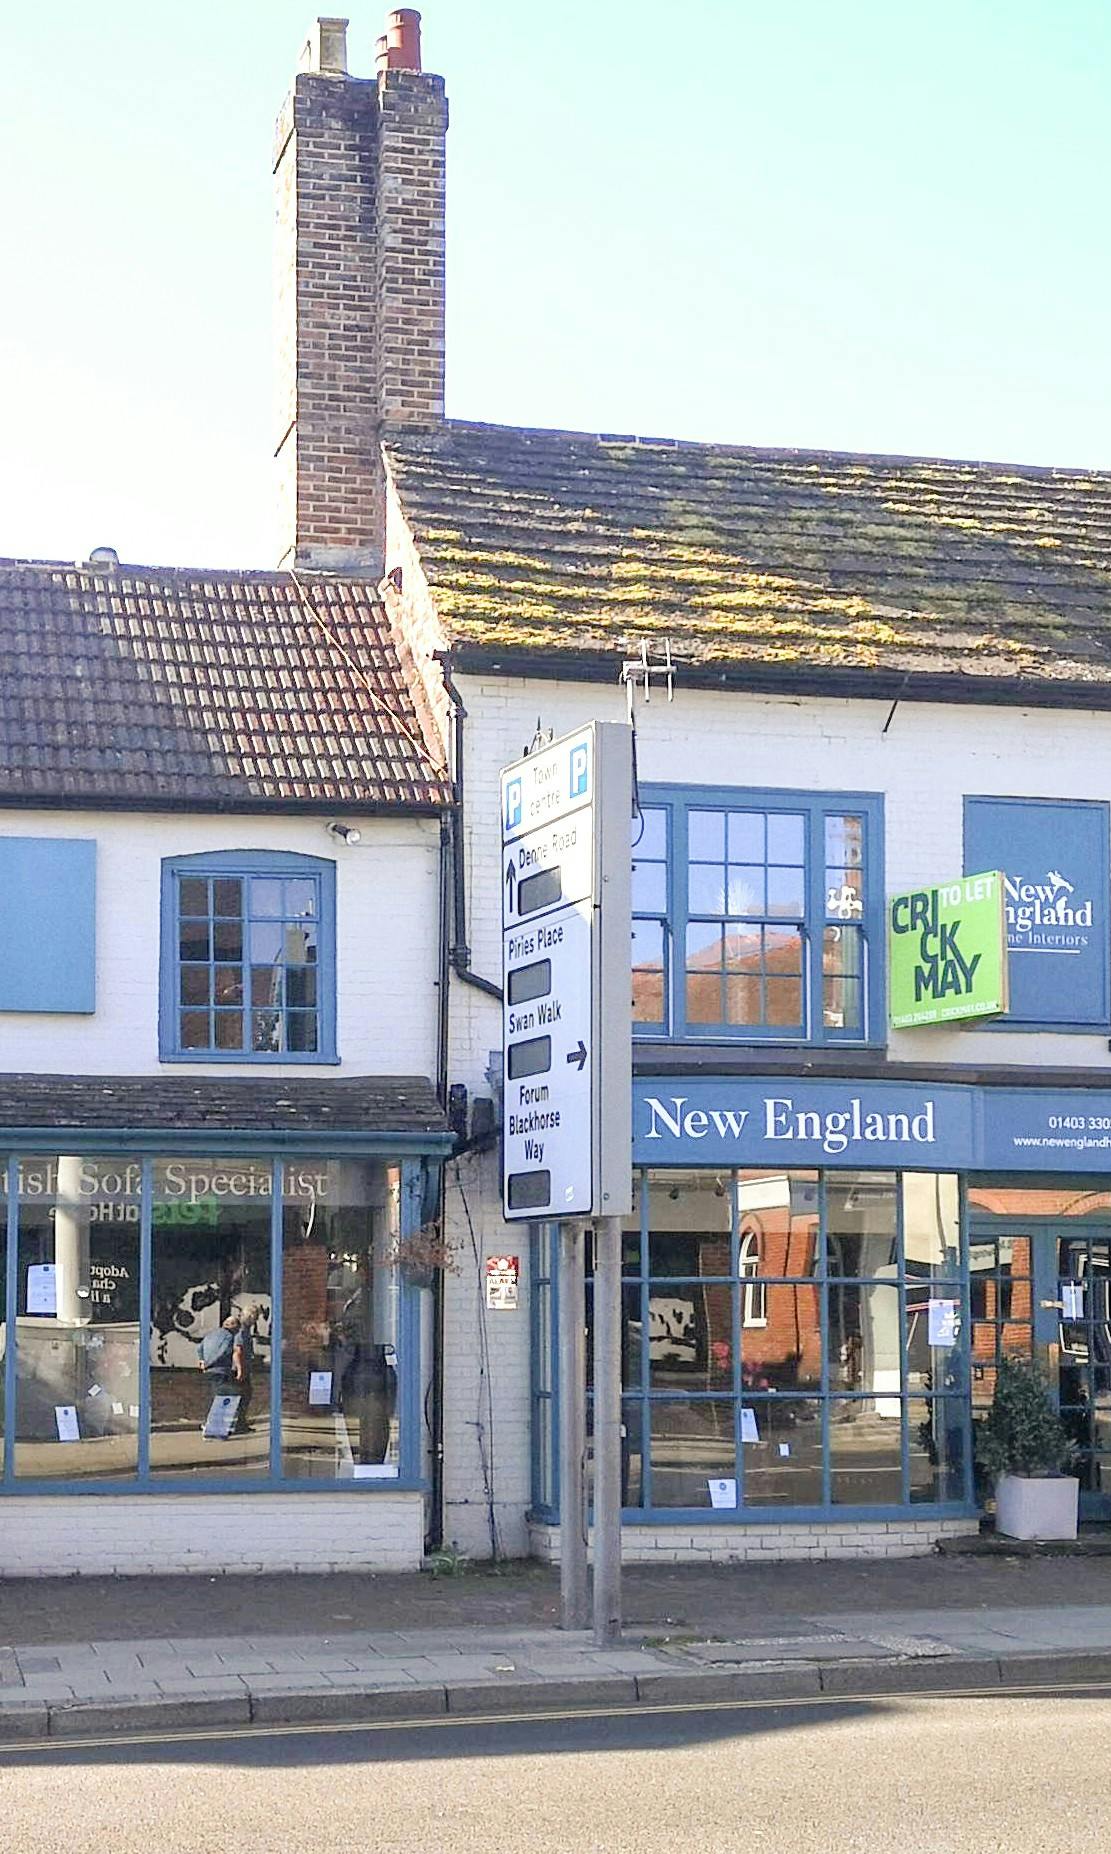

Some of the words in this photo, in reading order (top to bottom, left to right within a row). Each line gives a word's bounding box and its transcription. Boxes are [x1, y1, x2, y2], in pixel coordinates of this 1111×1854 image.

[533, 763, 558, 785] Town
[519, 844, 548, 870] Denne
[552, 825, 577, 852] Road
[939, 884, 961, 908] TO
[965, 877, 994, 902] LET
[1004, 876, 1058, 903] New
[892, 889, 938, 938] CRI
[1005, 896, 1093, 932] ngland
[508, 935, 535, 961] Piries
[537, 926, 564, 951] Place
[920, 920, 961, 963] CK
[1028, 931, 1089, 946] Interiors
[914, 953, 982, 1002] MAY
[509, 1012, 535, 1034] Swan
[537, 999, 562, 1026] Walk
[519, 1084, 550, 1106] Forum
[509, 1110, 561, 1136] Blackhorse
[644, 1097, 749, 1139] New
[763, 1098, 936, 1153] England
[1049, 1116, 1085, 1129] 01403
[524, 1139, 545, 1163] Way
[165, 1164, 329, 1204] Specialist
